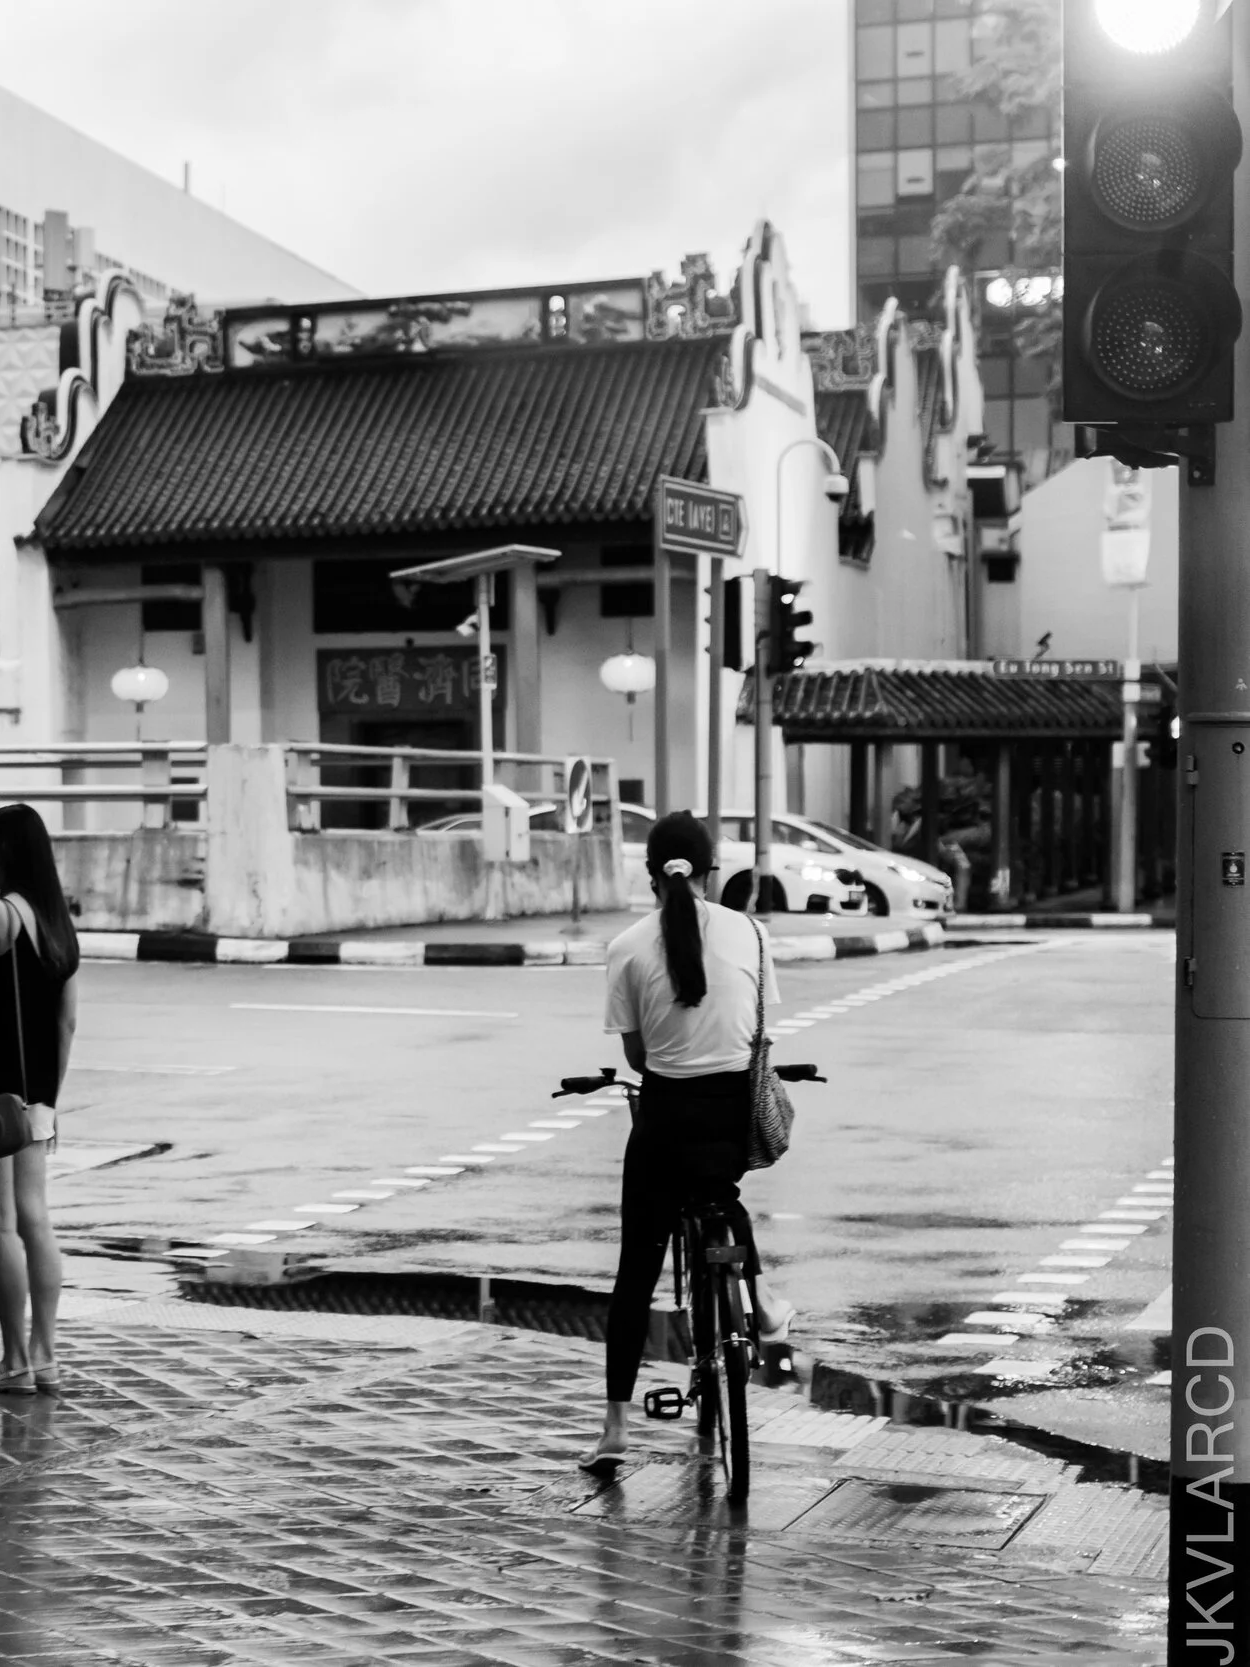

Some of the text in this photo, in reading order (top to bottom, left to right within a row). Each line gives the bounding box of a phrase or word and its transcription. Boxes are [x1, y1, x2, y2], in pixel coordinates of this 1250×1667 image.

[666, 498, 685, 527] CTE
[1022, 659, 1060, 678] Tong
[1064, 660, 1093, 675] Sen
[1096, 660, 1114, 675] St
